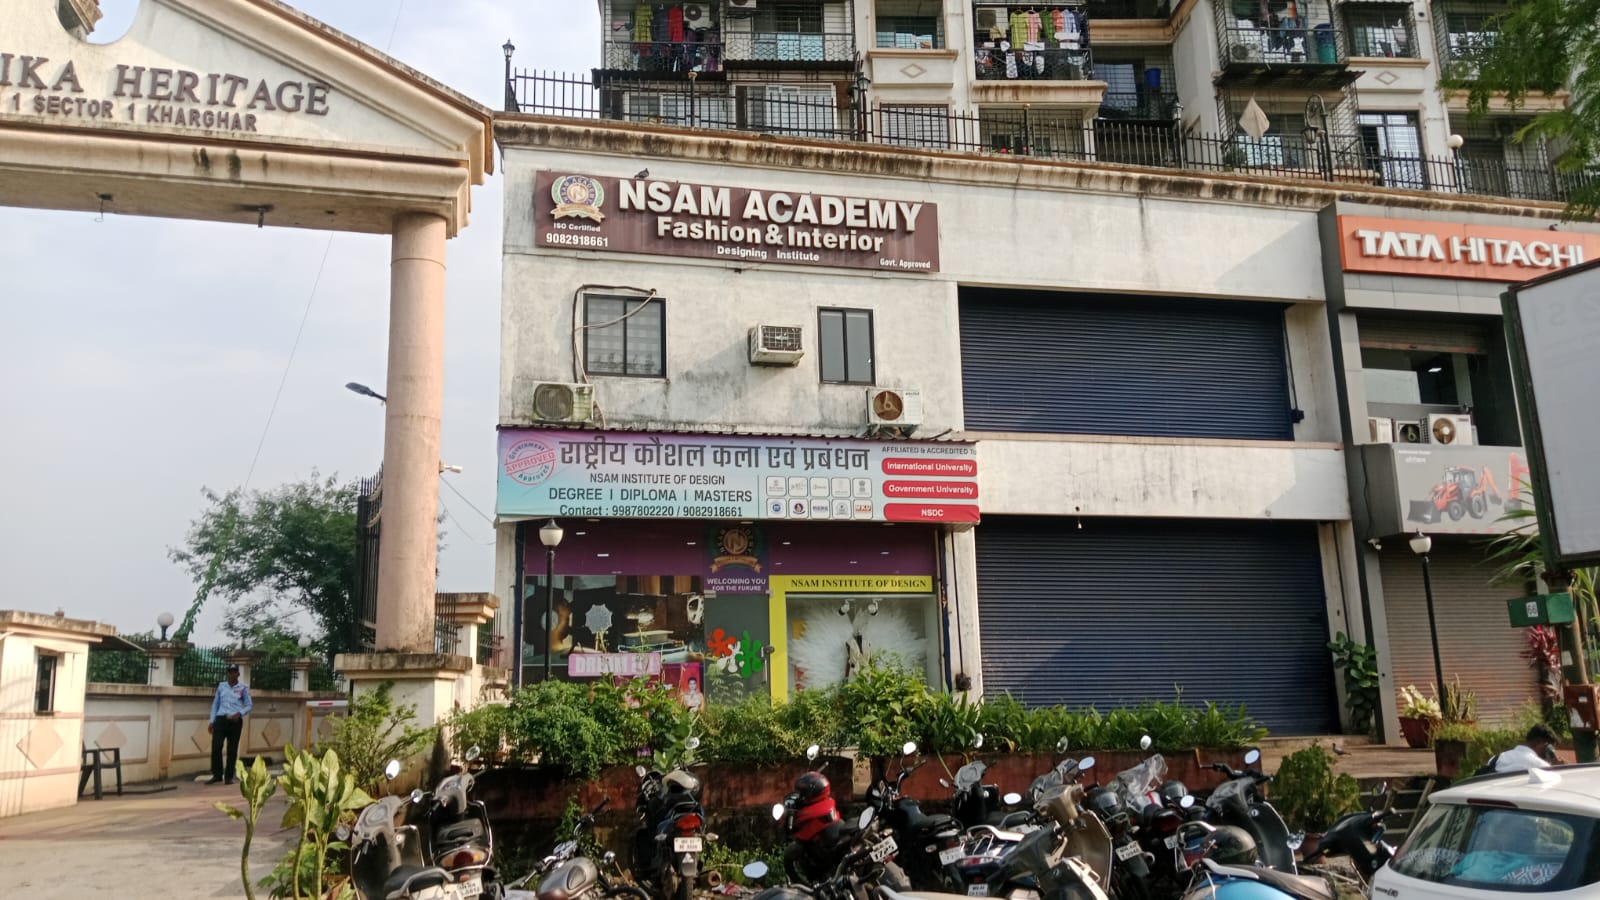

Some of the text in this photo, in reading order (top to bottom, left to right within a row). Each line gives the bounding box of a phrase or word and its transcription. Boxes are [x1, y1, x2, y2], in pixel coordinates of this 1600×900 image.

[113, 64, 330, 116] HERITAGE
[13, 92, 257, 132] 1 SECTOR 1 KHARGHAR
[619, 179, 922, 231] NSAM ACADEMY
[553, 222, 601, 232] ISO Certified
[657, 216, 883, 252] Fashion & Interior
[546, 232, 608, 247] 9082918661
[717, 246, 820, 262] Designing Institute
[1355, 229, 1584, 268] TATA HITACHI
[880, 257, 931, 269] Govt. Approved
[559, 435, 870, 471] राष्ट्रीय कौशल कला एवं प्रबंधन
[882, 446, 919, 454] AFFILIATED
[927, 447, 968, 455] ACCREDITED
[506, 451, 554, 473] APPROVED
[887, 462, 973, 473] International University
[590, 473, 725, 485] NSAM INSTITUTE OF DESIGN
[549, 488, 602, 500] DEGREE
[621, 489, 677, 501] DIPLOMA
[694, 490, 752, 502] MASTERS
[888, 484, 974, 496] Government University
[559, 504, 602, 517] Contact
[612, 505, 674, 517] 9987802220
[683, 505, 742, 518] 9082918661
[921, 508, 944, 517] NSDC
[707, 577, 750, 585] WELCOMING
[791, 579, 926, 588] NSAM INSTITUTE OF DESIGN
